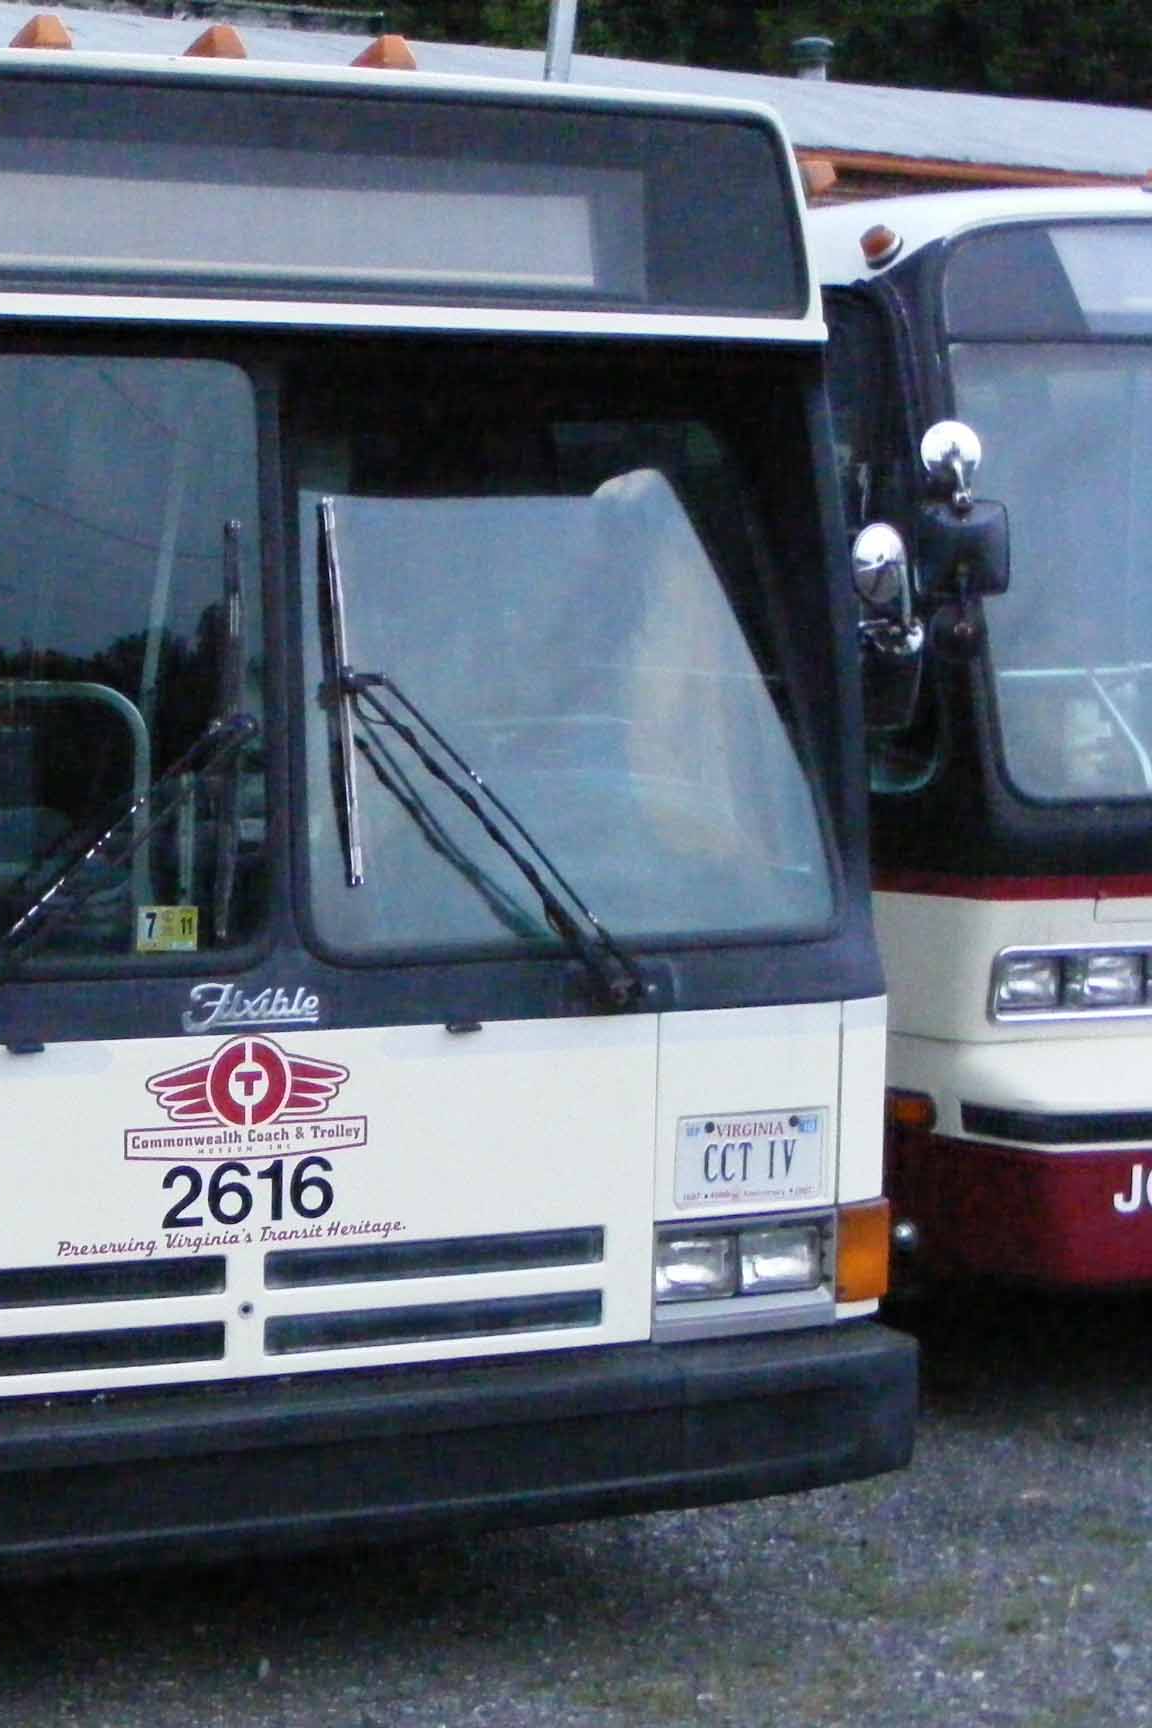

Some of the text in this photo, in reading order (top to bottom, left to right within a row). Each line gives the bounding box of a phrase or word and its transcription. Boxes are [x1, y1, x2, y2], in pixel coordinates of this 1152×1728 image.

[145, 911, 157, 939] 7
[131, 1123, 361, 1150] Commonwealth Coach & Trolley
[716, 1121, 784, 1138] VIRGINIA
[704, 1138, 796, 1183] CCT IV
[161, 1156, 335, 1230] 2616
[56, 1219, 408, 1257] Preserving Virginia's Transit Heritage.
